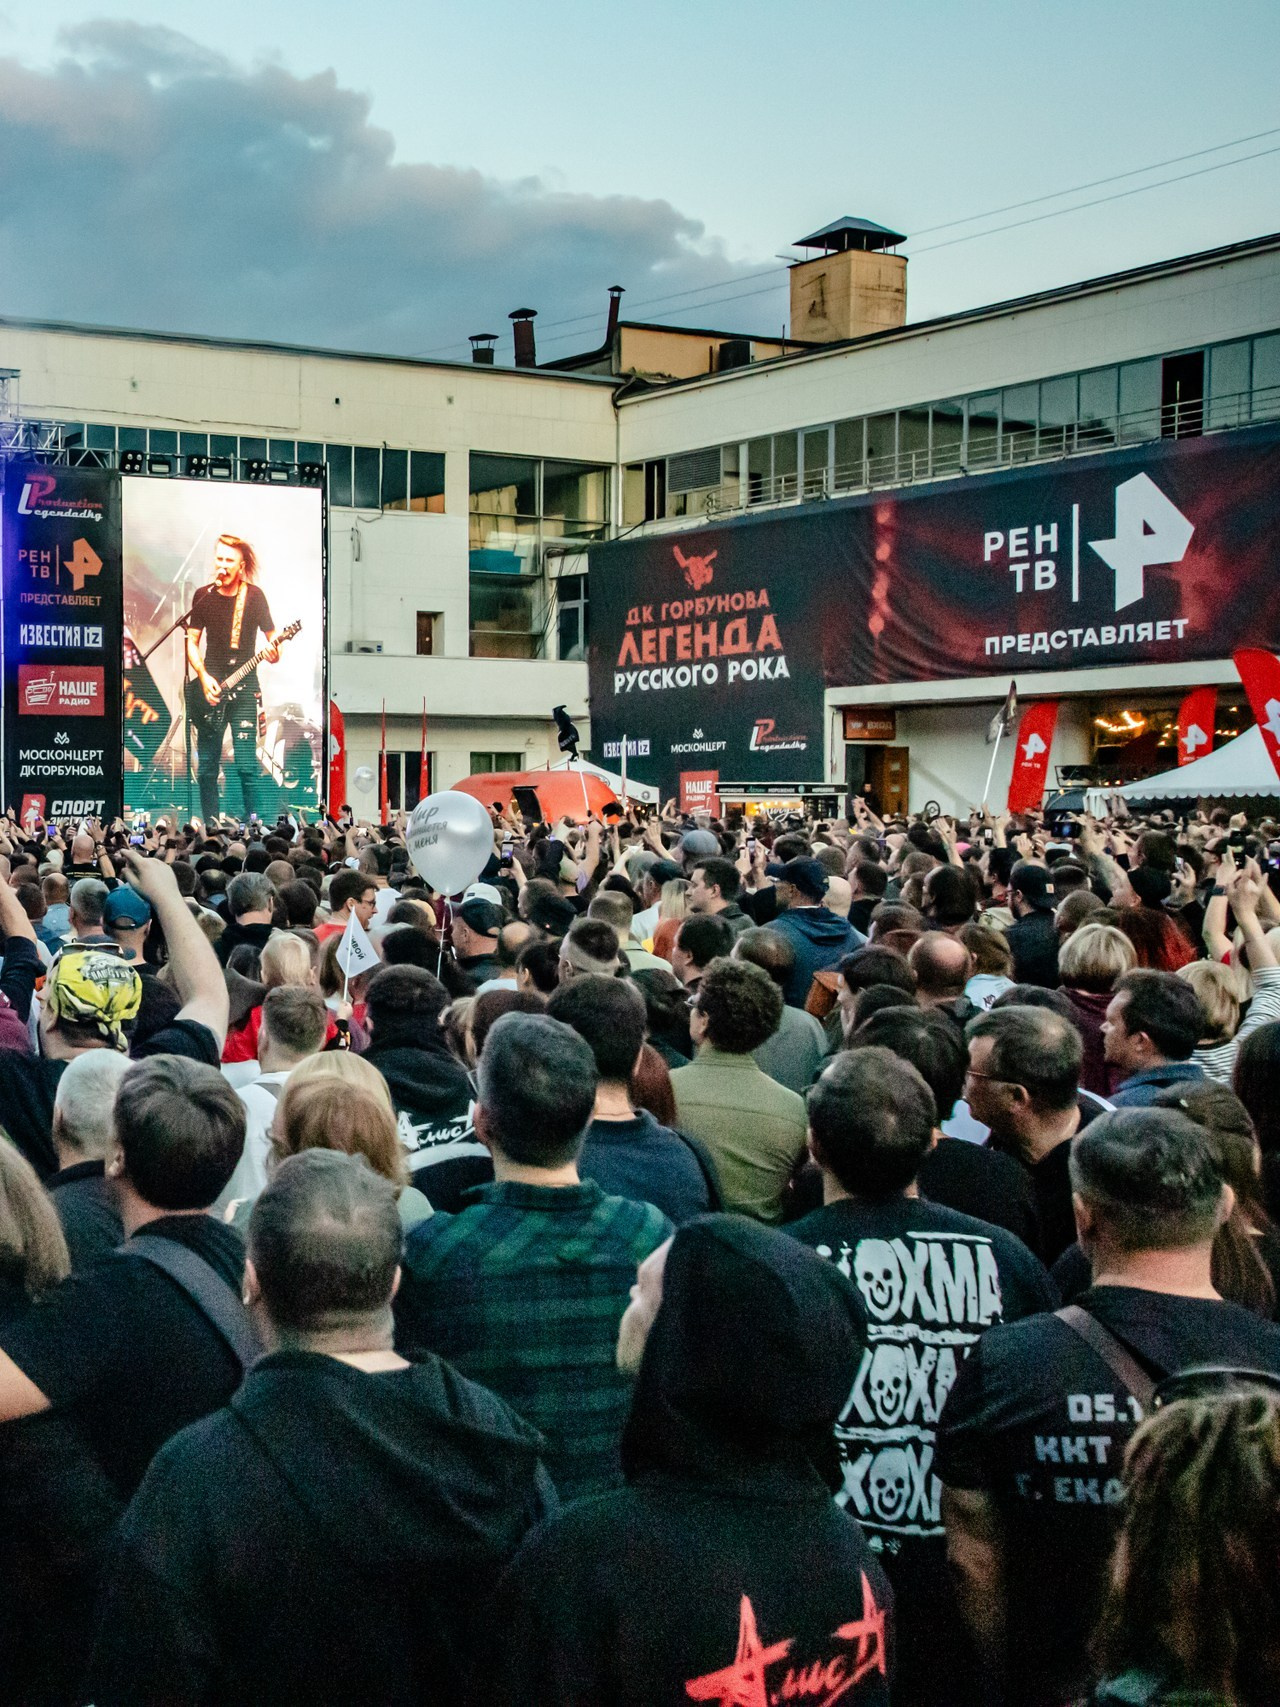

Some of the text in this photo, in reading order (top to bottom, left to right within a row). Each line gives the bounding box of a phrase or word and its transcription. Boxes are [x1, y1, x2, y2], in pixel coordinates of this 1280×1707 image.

[983, 522, 1059, 562] РЕН
[18, 549, 51, 563] РЕН
[30, 565, 50, 578] ТВ
[1008, 560, 1058, 593] ТВ
[20, 593, 102, 607] ПРЕДСТАВЛЯЕТ
[625, 588, 770, 626] ДК ГОРБУНОВА
[20, 624, 81, 646] ИЗВЕСТИЯ
[617, 613, 783, 667] ЛЕГЕНДА
[984, 618, 1190, 656] ПРЕДСТАВЛЯЕТ
[614, 655, 791, 696] РУССКОГО РОКА
[59, 680, 97, 696] НАШЕ
[59, 697, 90, 706] РАДИО
[603, 741, 637, 757] ИЗВЕИЯ
[671, 741, 727, 753] МОСКОНЦЕРТ
[19, 749, 103, 763] МОСКОНЦЕРТ
[20, 765, 104, 778] ДК ГОРБУНОВА
[685, 780, 712, 793] НАШЕ
[51, 800, 105, 815] СПОРТ
[351, 935, 367, 960] ИВОЙ
[1034, 1435, 1112, 1464] ККТ
